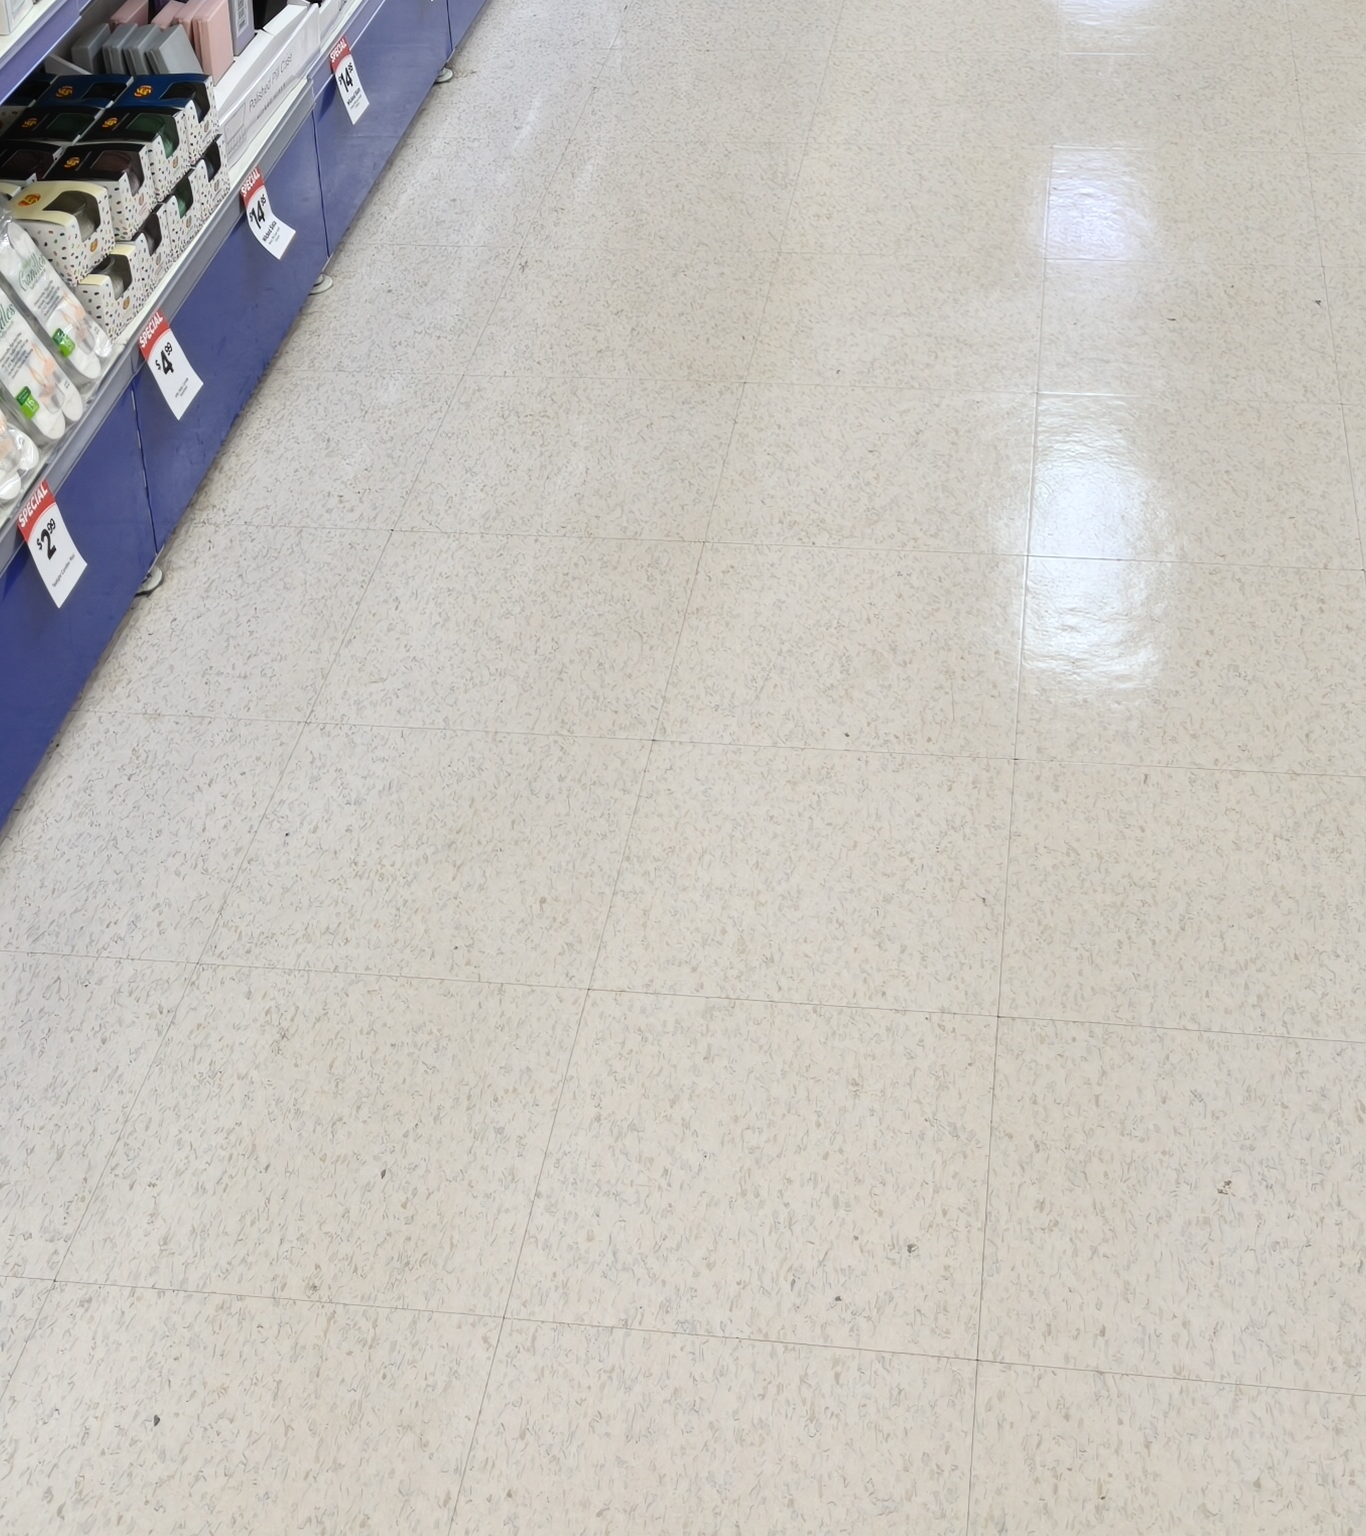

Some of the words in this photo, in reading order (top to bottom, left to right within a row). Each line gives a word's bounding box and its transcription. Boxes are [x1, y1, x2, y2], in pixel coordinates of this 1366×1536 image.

[329, 37, 348, 62] SPECIAL
[241, 168, 260, 197] SPECIAL
[140, 312, 163, 348] SPECIAL
[17, 486, 48, 528] SPECIAL
